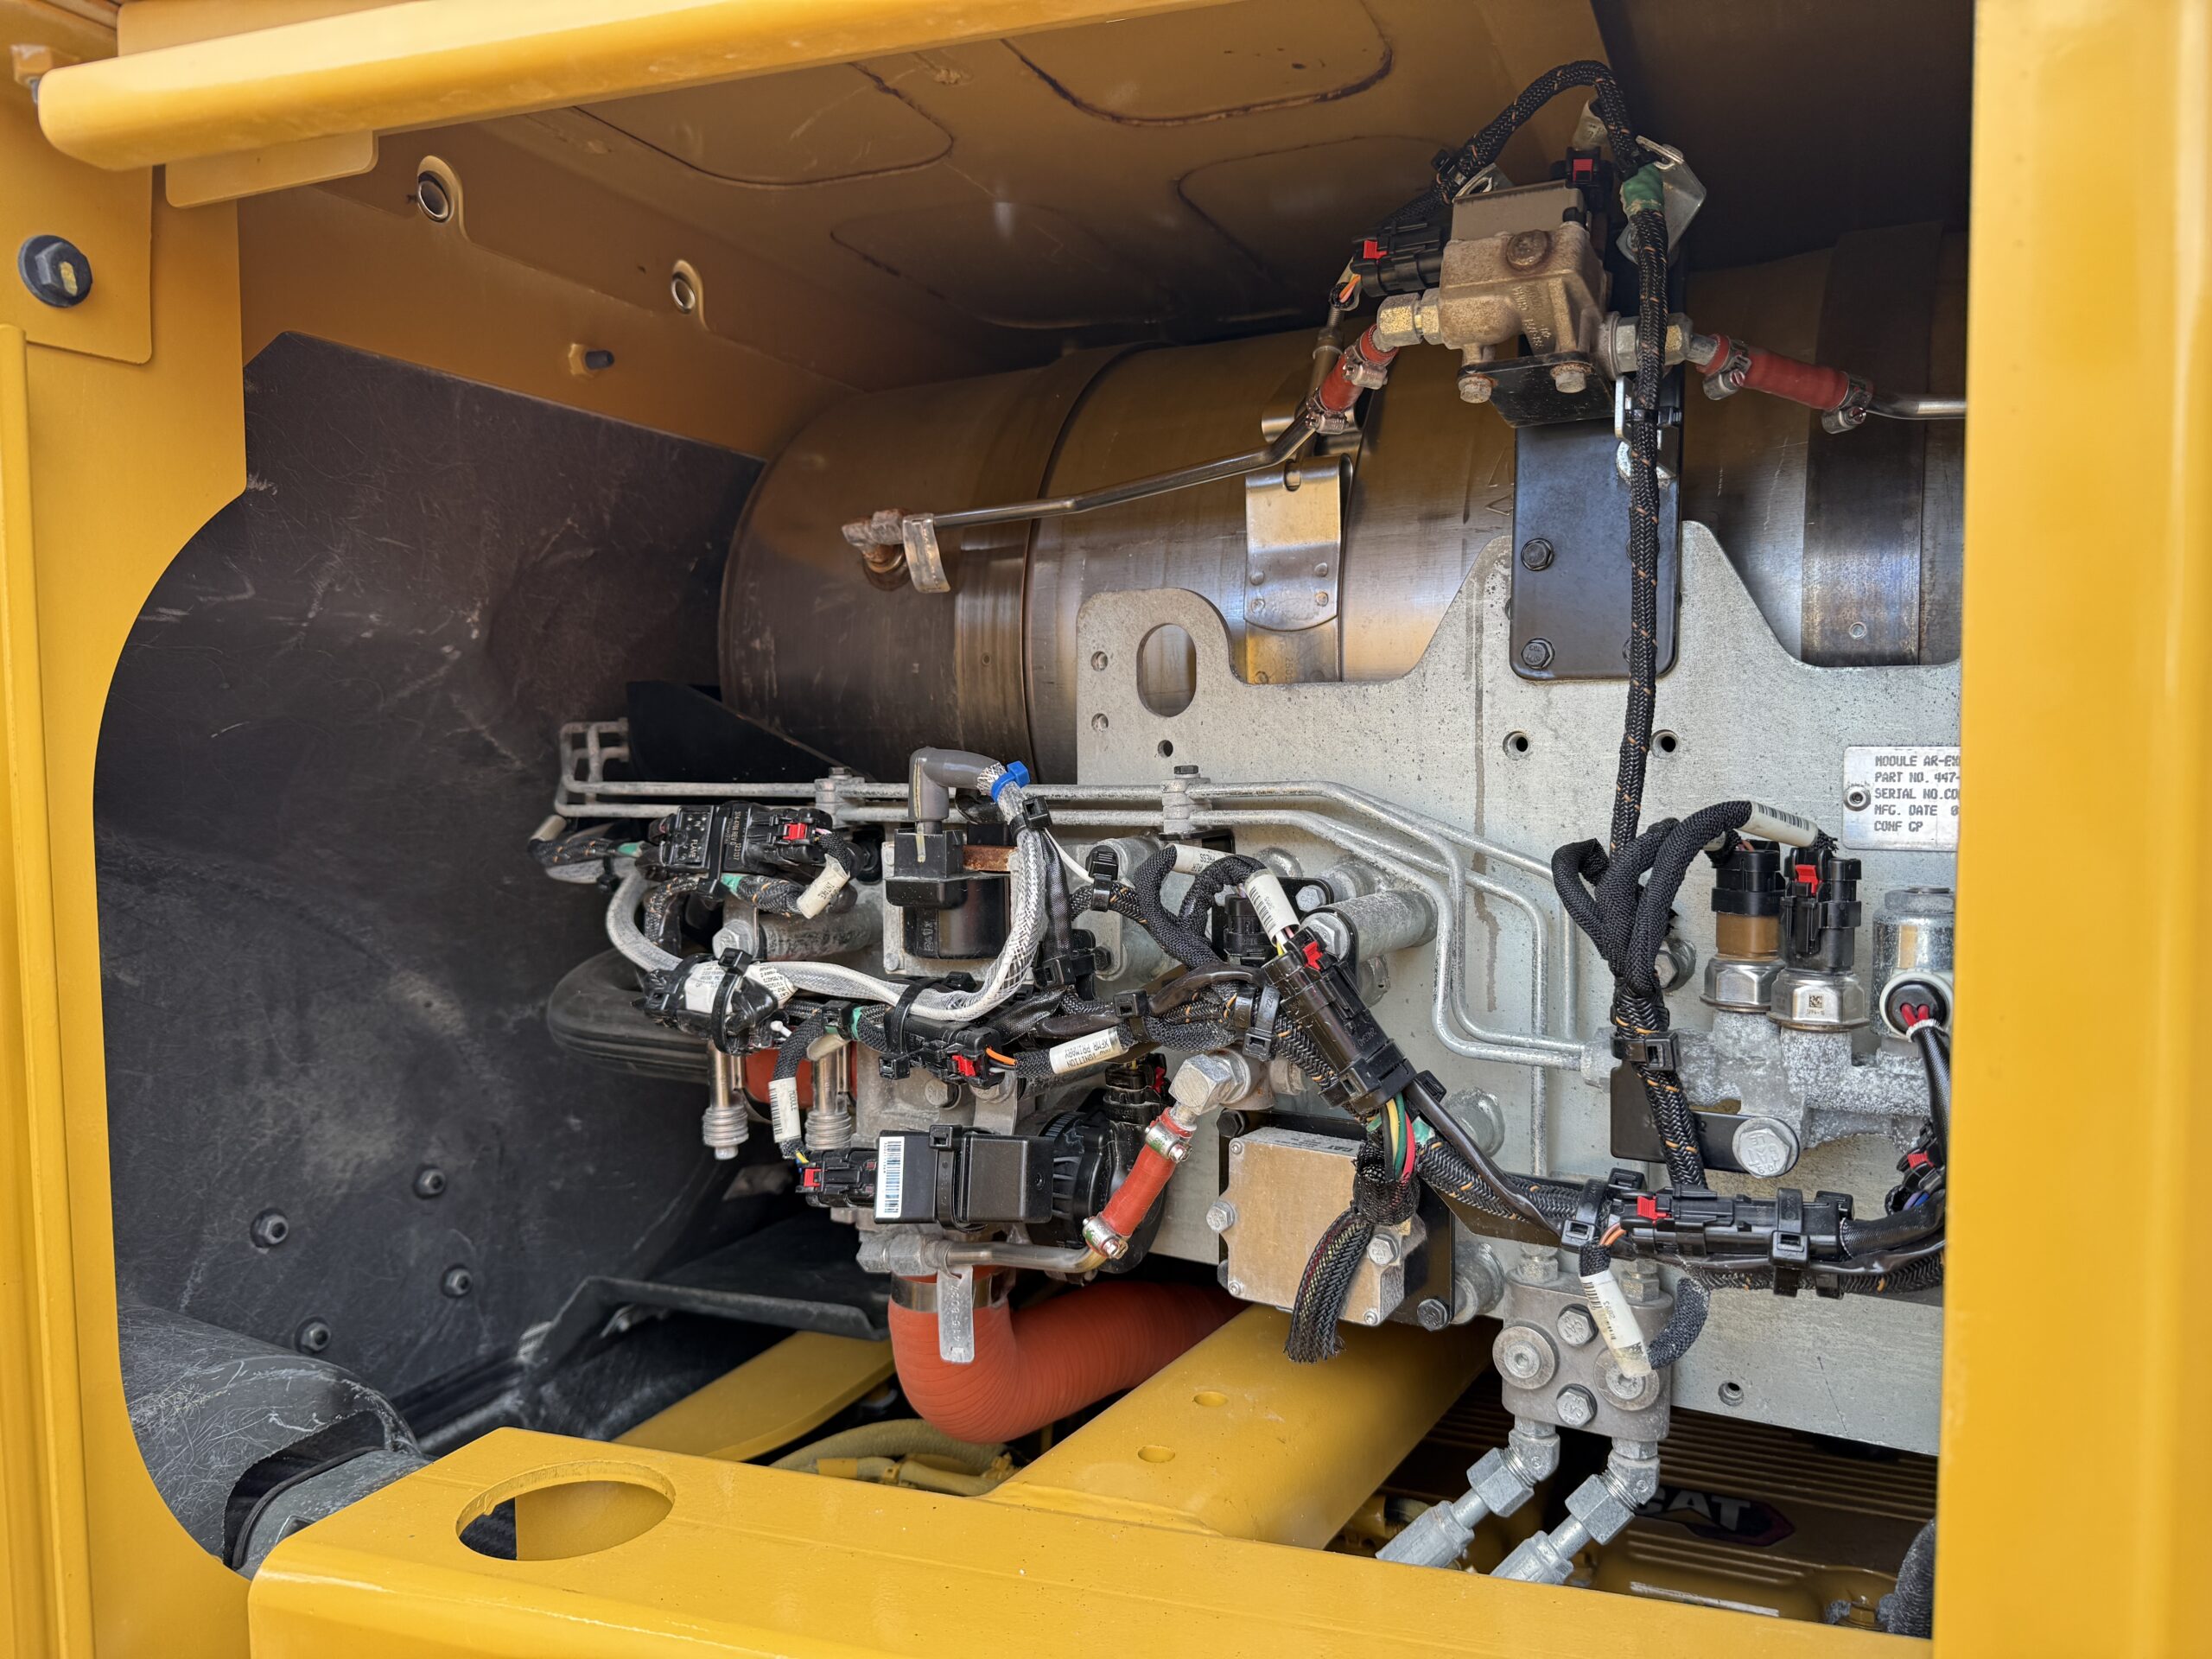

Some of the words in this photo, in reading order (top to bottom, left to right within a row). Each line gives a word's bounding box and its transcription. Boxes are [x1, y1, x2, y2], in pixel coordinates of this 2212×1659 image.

[1874, 754, 1918, 767] MODULE
[1923, 755, 1961, 767] AR-EX
[1874, 772, 1904, 783] PART
[1909, 772, 1929, 784] NO.
[1874, 788, 1916, 800] SERIAL
[1873, 804, 1902, 817] MFG.
[1908, 804, 1938, 817] DATE
[1873, 820, 1903, 832] CONF
[1908, 821, 1924, 832] GP
[688, 838, 698, 859] FLAME
[1191, 862, 1205, 873] AIR
[1066, 1052, 1097, 1069] IGNITION
[1323, 1144, 1355, 1153] CAT
[1746, 1143, 1782, 1166] CAT
